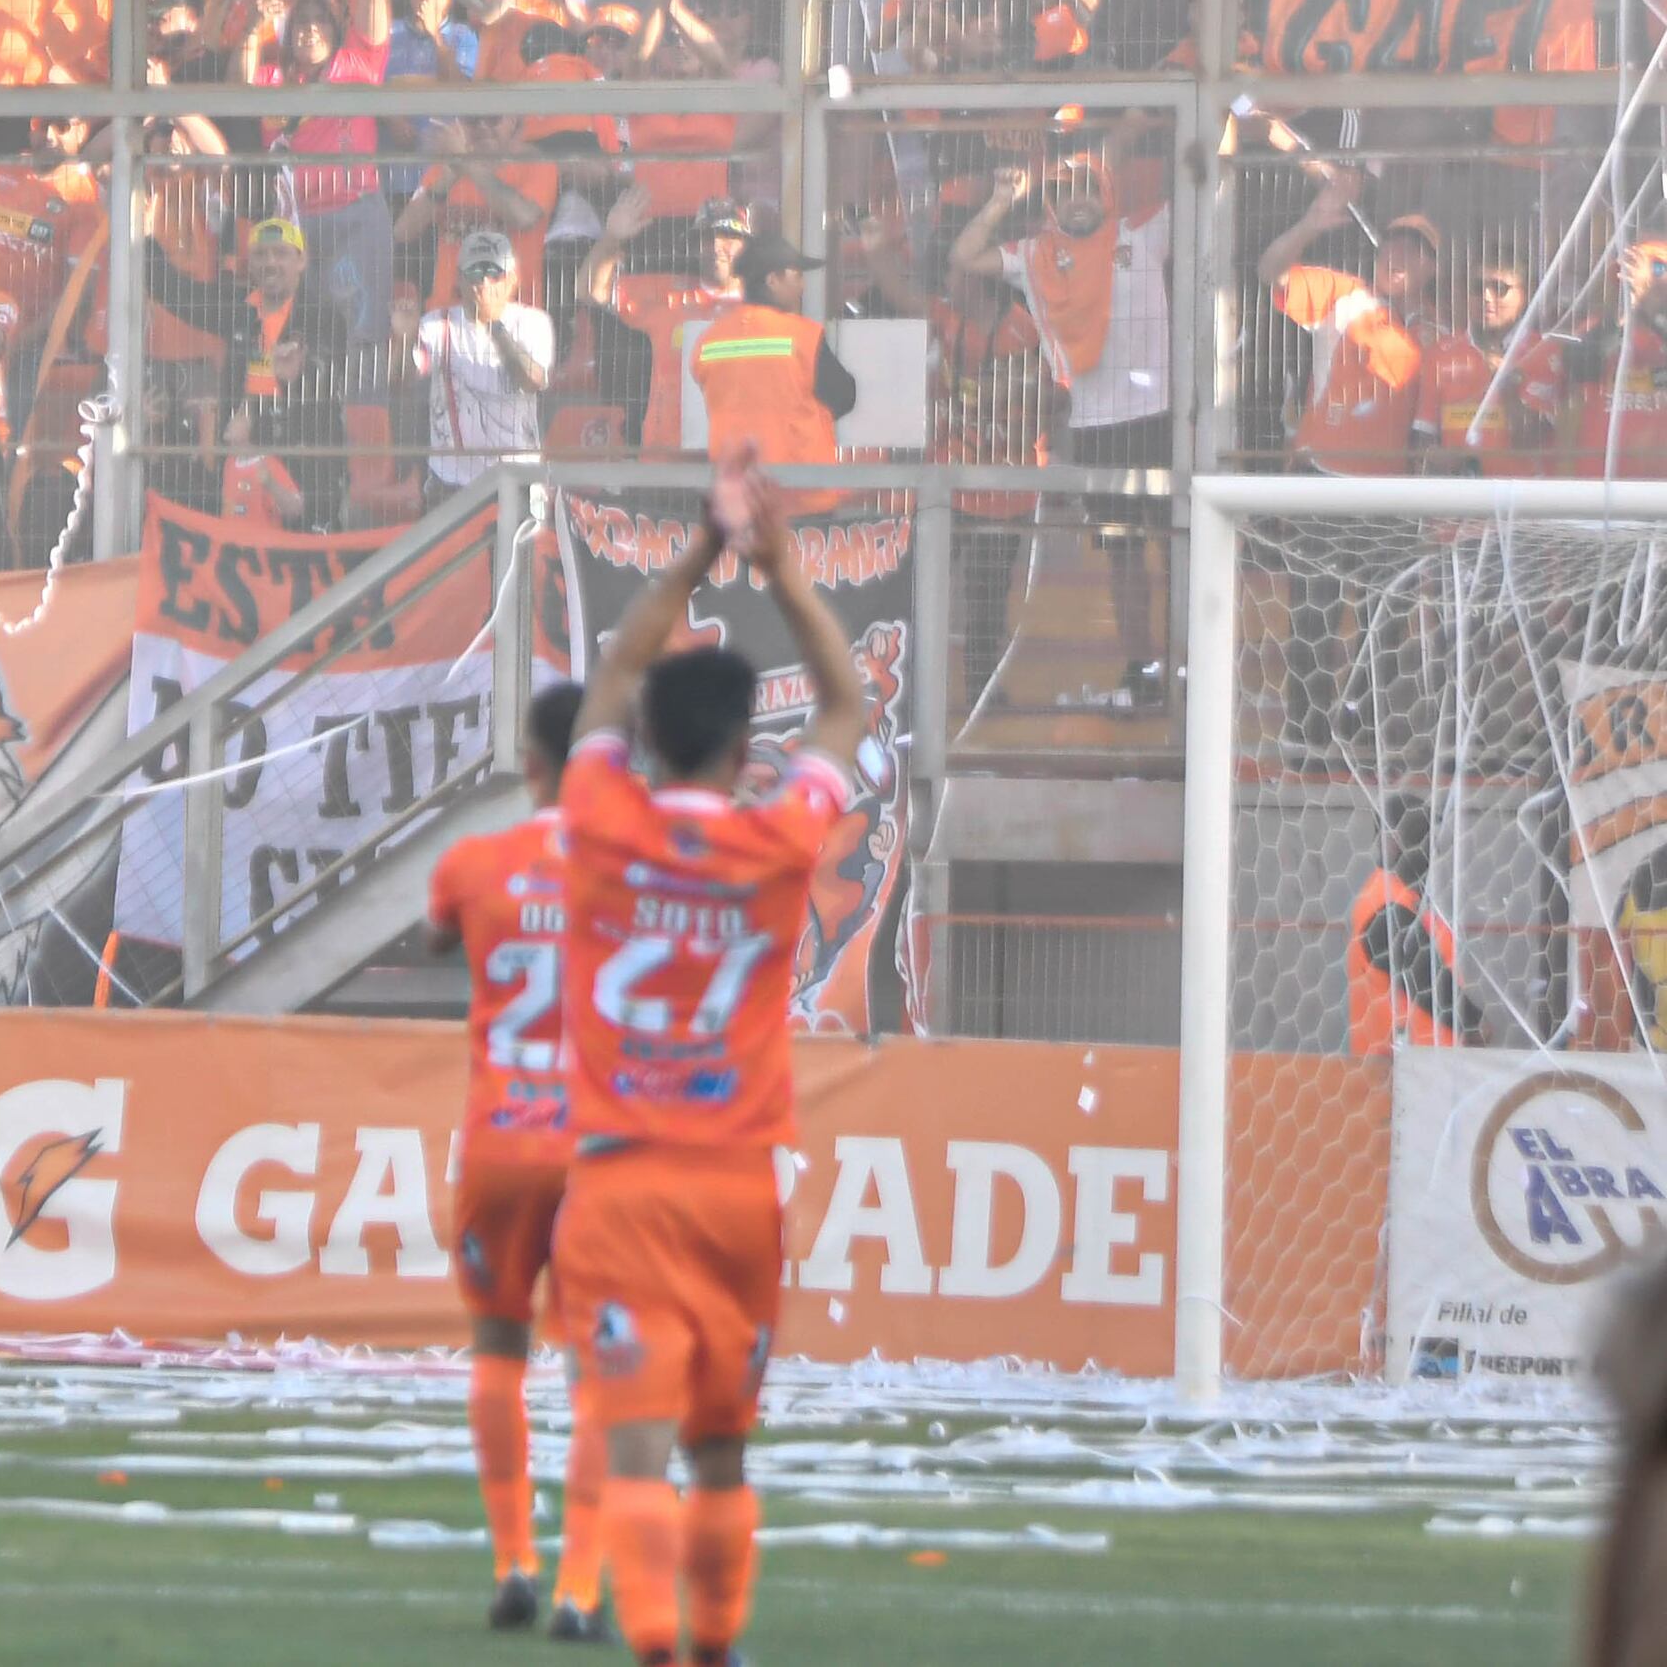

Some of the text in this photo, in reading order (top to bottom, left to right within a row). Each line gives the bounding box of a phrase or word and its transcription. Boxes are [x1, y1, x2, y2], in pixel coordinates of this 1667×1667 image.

[485, 941, 564, 1072] 2
[1505, 1128, 1575, 1161] EL
[1499, 1301, 1528, 1326] de
